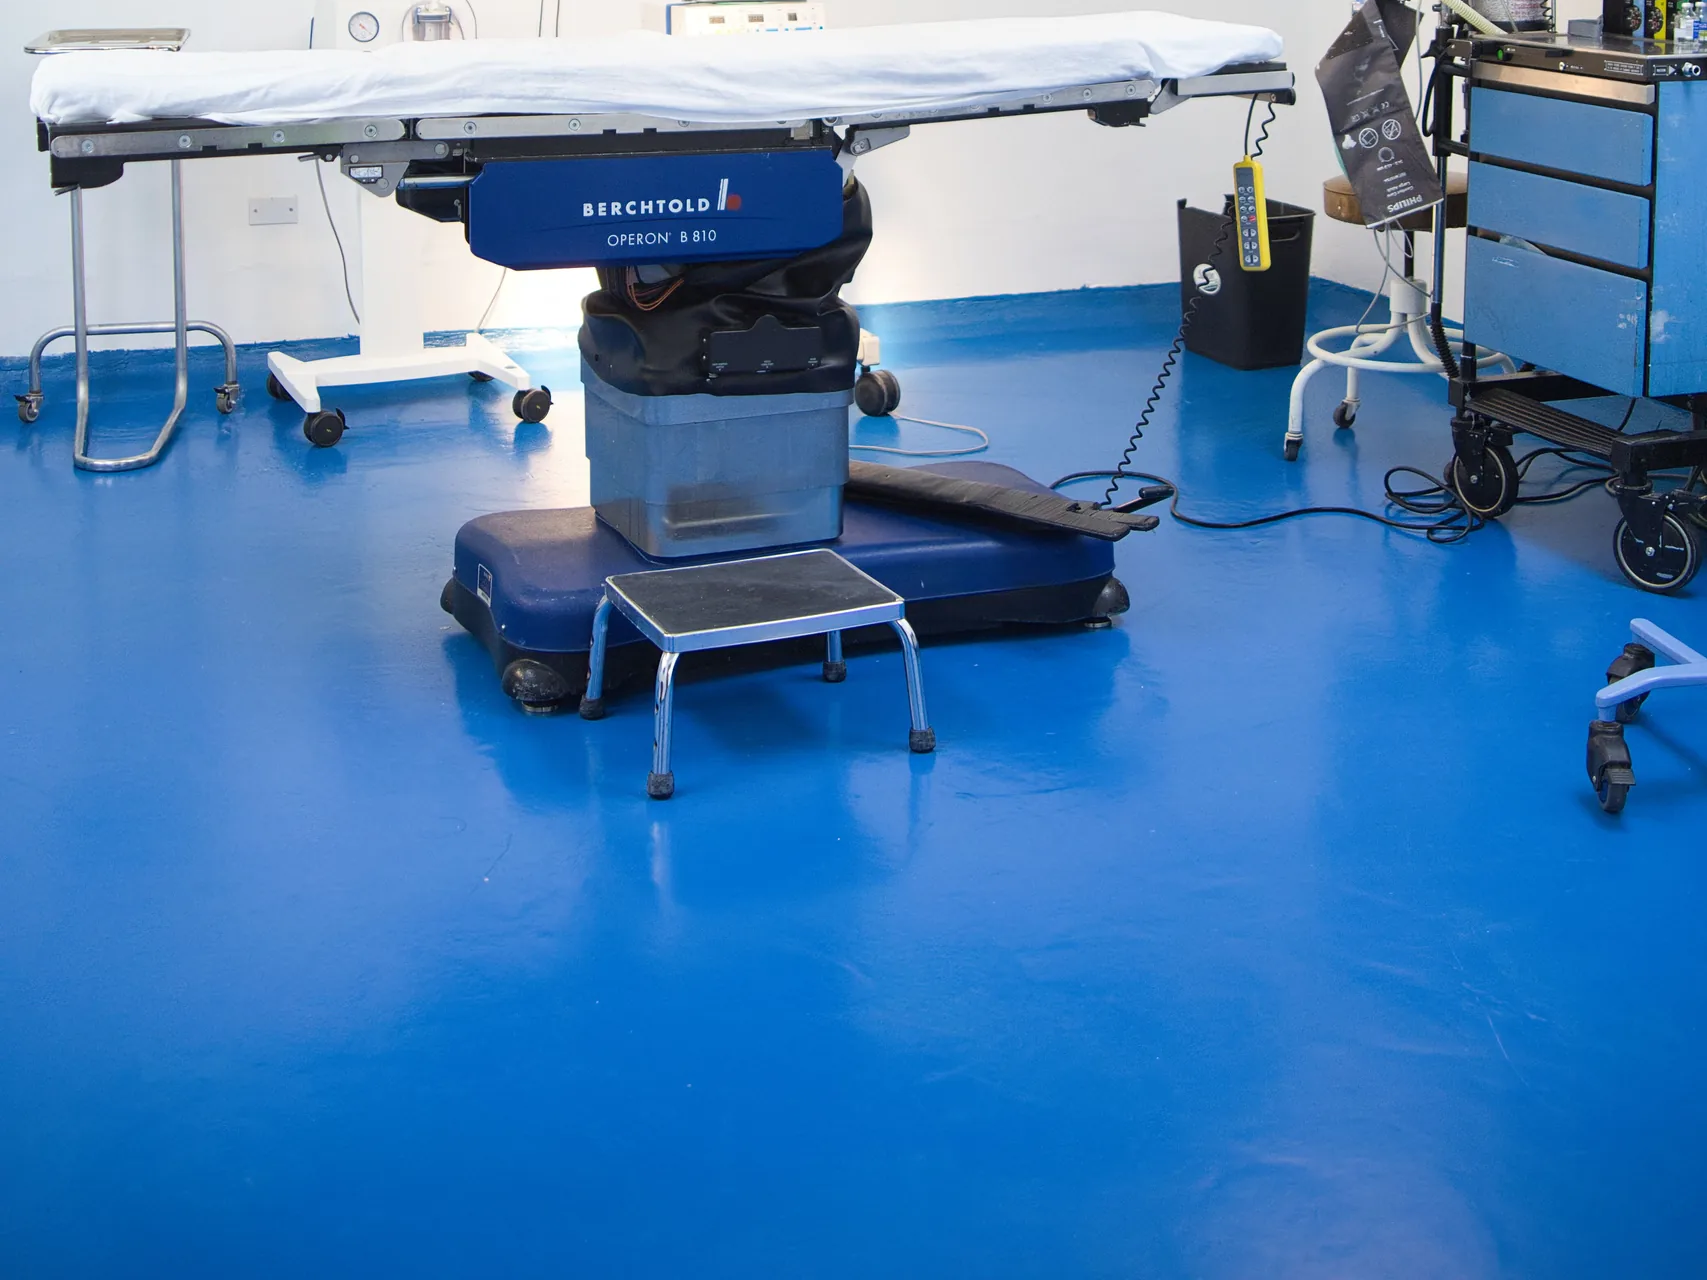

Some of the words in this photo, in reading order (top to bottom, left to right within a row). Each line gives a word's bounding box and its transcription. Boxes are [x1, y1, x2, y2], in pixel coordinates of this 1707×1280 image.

[582, 197, 711, 217] BERCHTOLD
[1387, 194, 1423, 212] PHILIPS
[680, 230, 688, 243] B
[692, 229, 717, 243] 810
